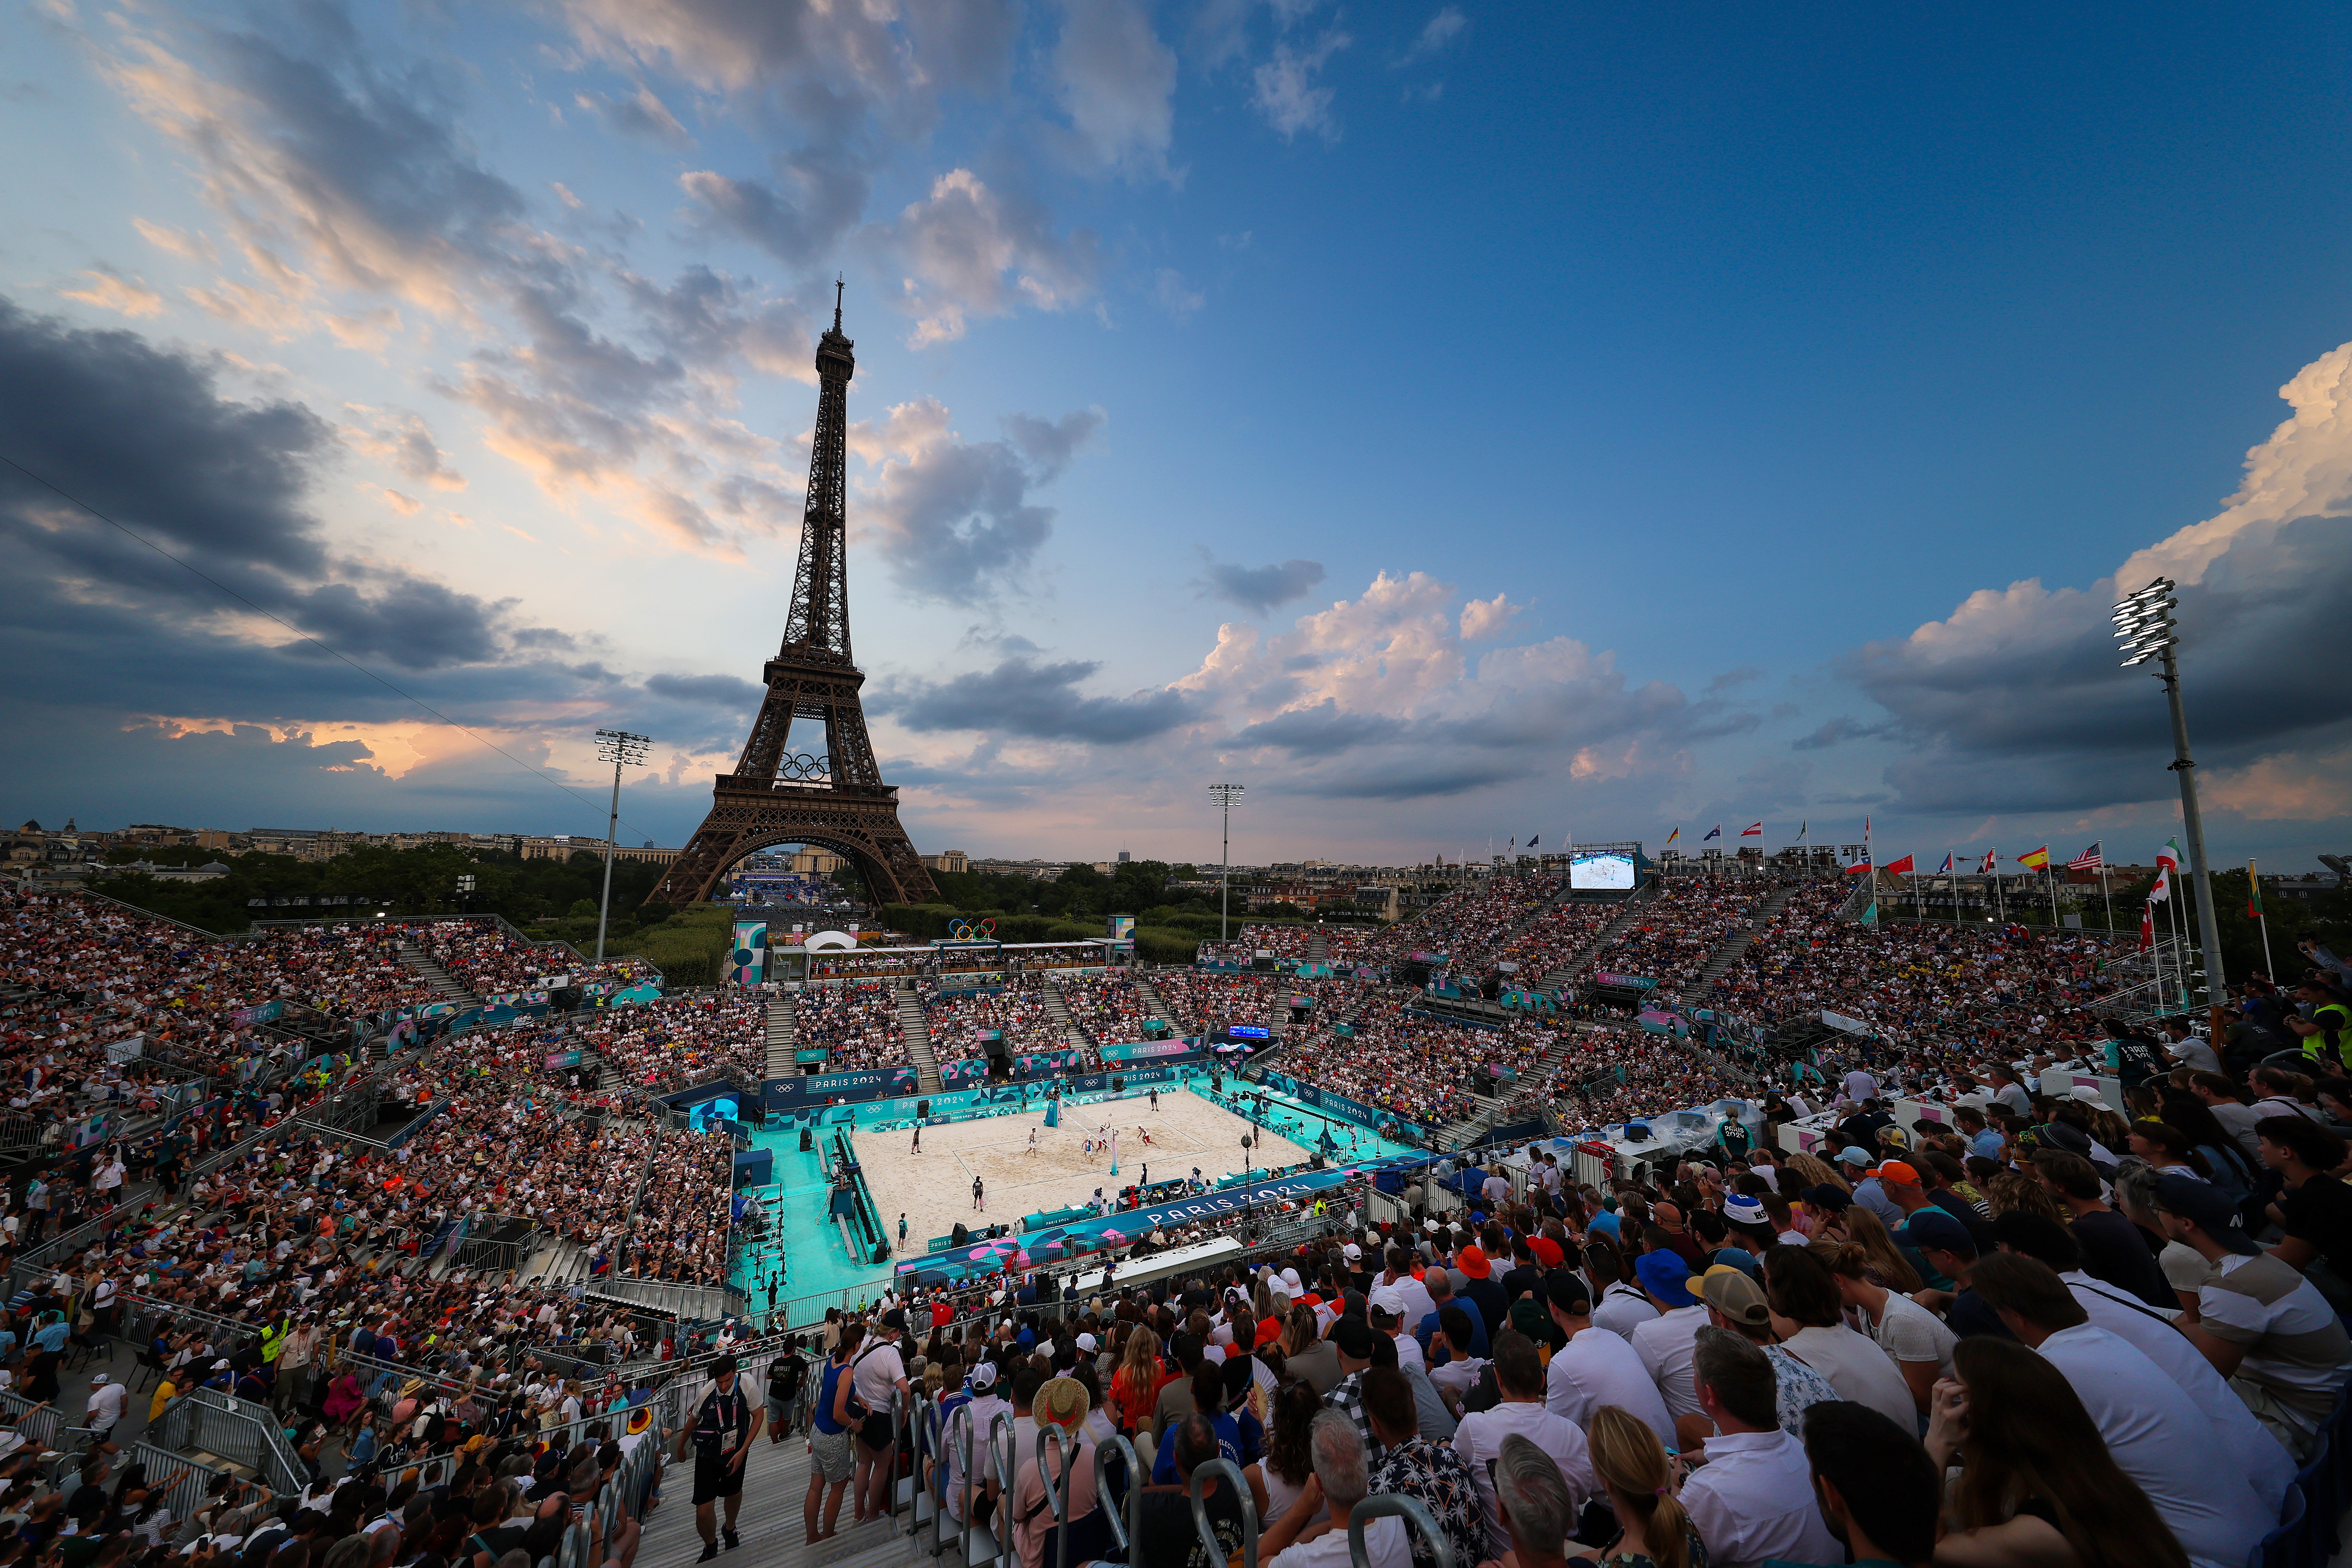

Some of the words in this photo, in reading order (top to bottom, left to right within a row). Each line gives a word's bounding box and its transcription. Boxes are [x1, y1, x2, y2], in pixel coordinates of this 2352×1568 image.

[1139, 1071, 1160, 1080] 2024
[853, 1076, 881, 1085] 2024
[937, 1096, 964, 1105] 2024
[1348, 1106, 1367, 1120] 2024
[1240, 1184, 1312, 1203] 2024
